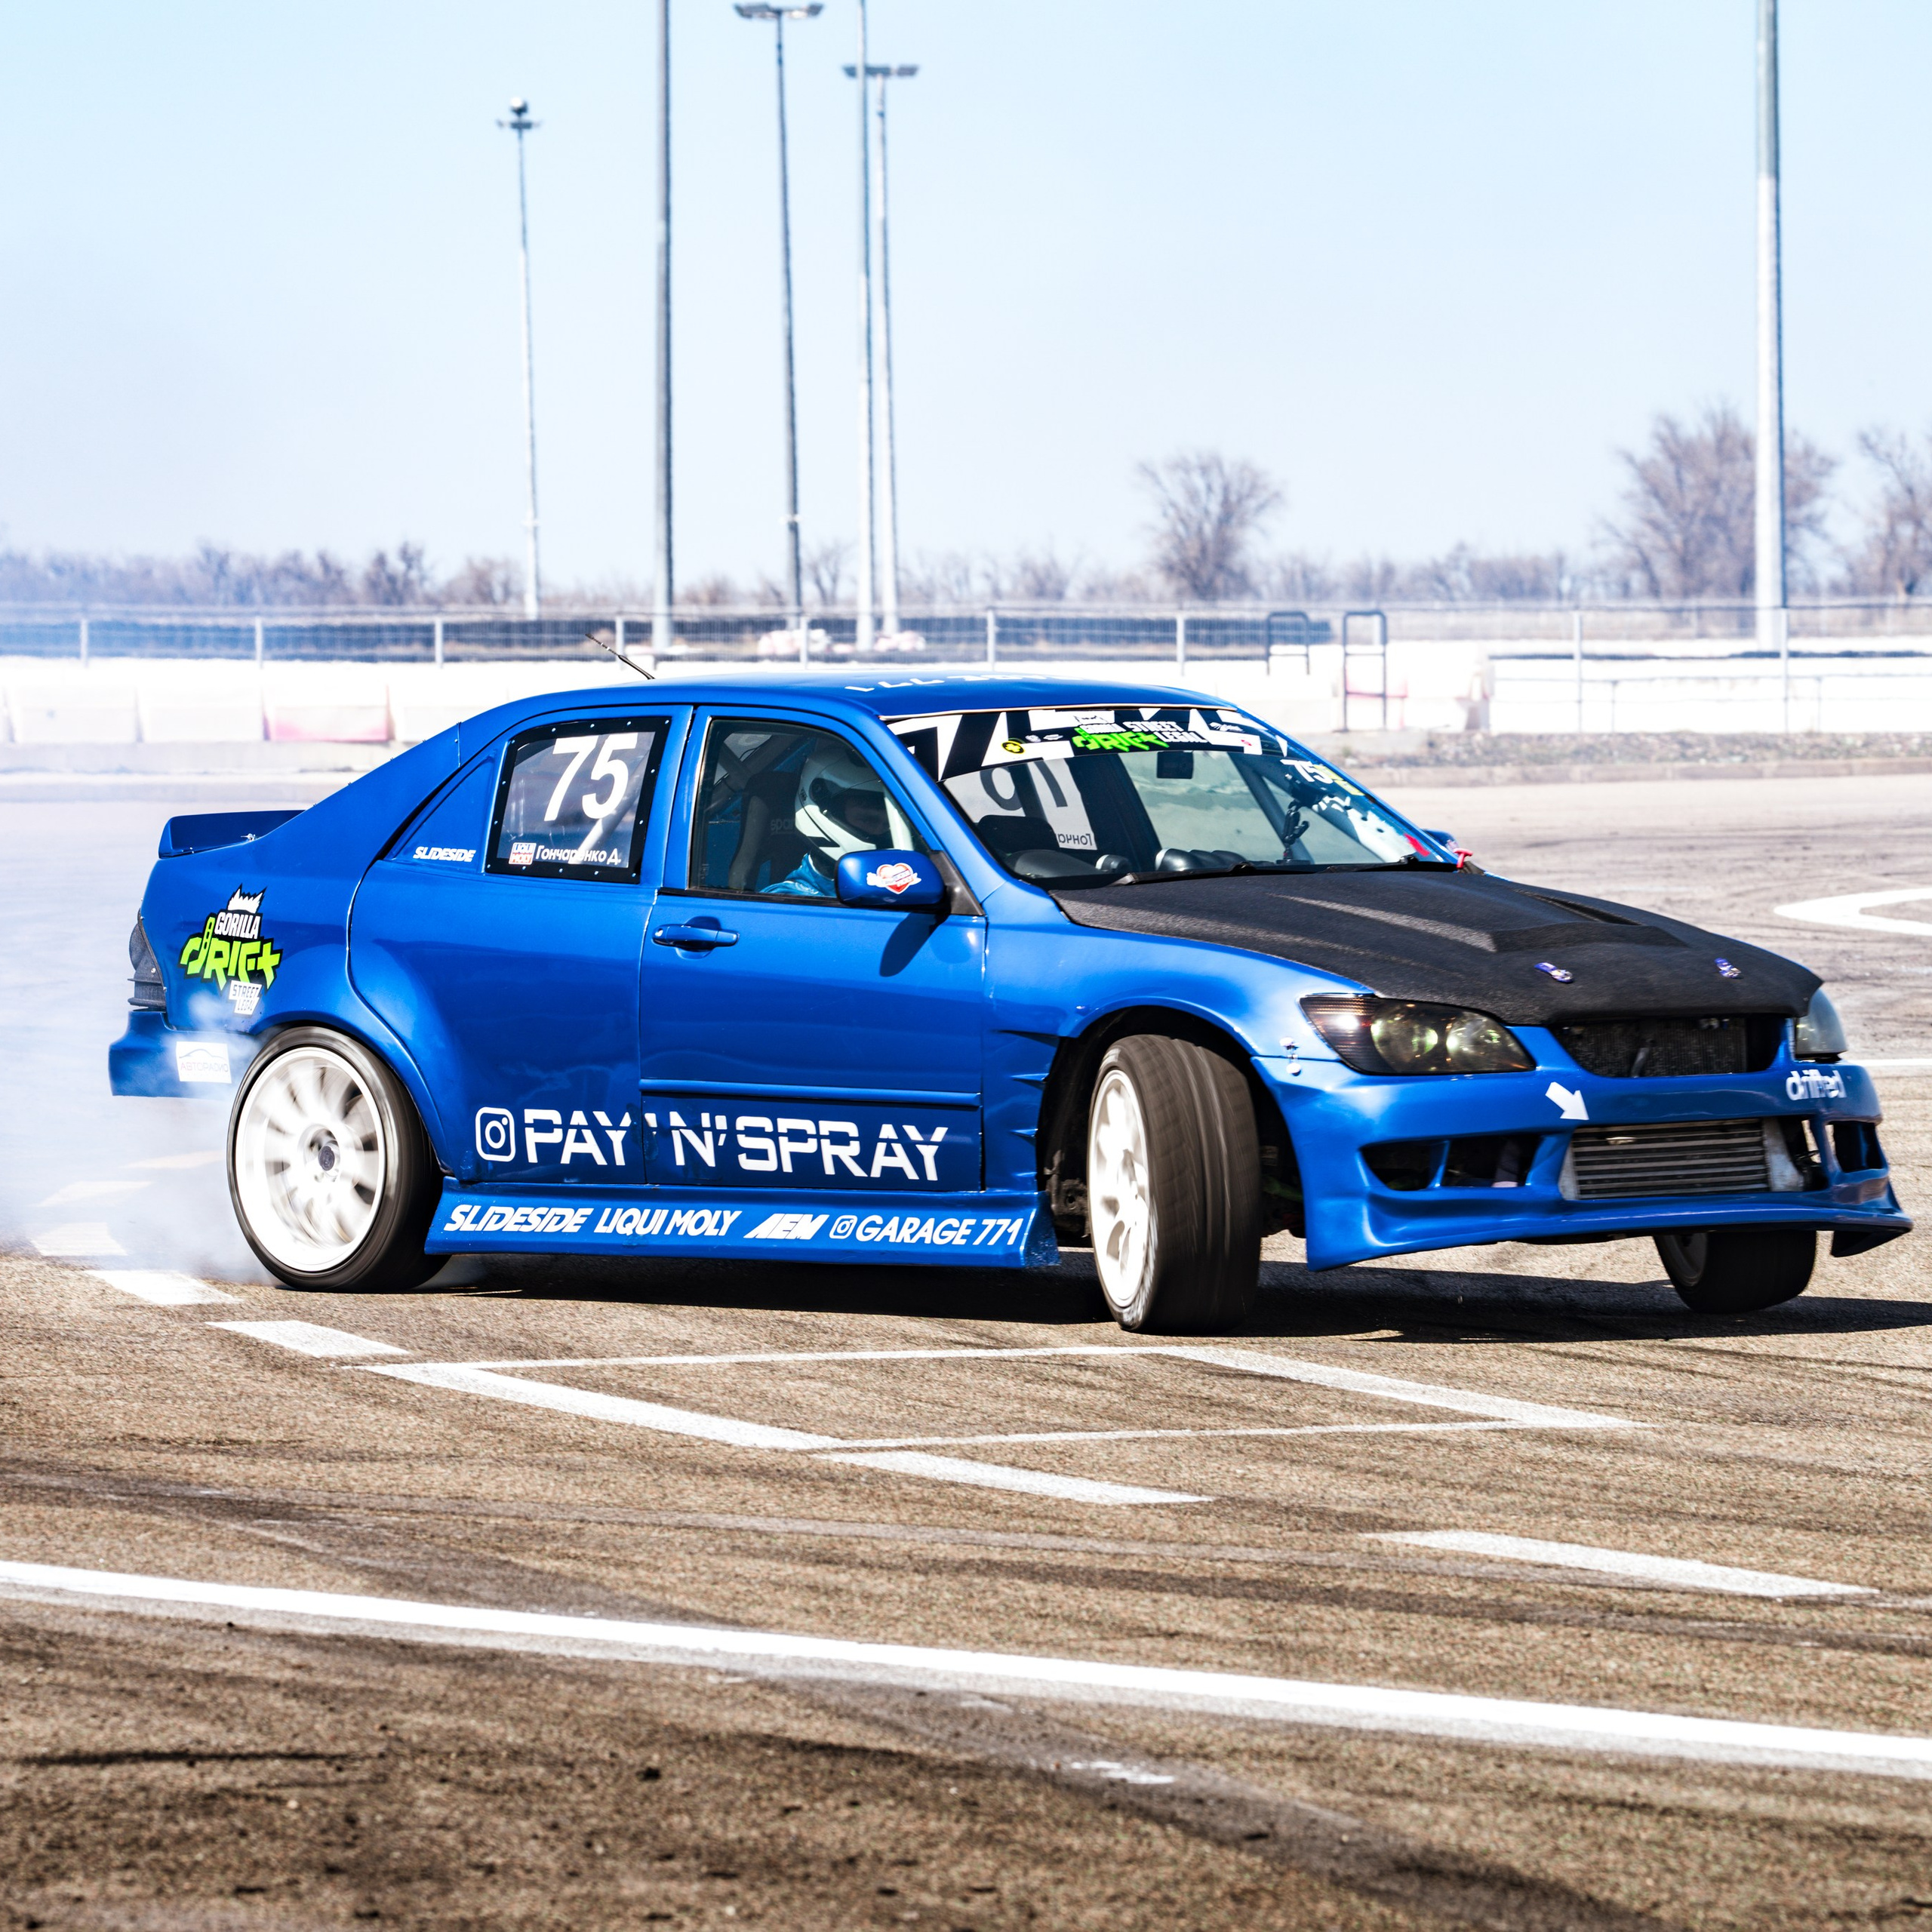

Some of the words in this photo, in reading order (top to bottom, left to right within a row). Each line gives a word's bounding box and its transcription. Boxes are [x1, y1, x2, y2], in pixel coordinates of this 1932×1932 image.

[543, 732, 638, 822] 75
[1280, 758, 1334, 784] 75
[413, 846, 476, 863] SLIDESIDE
[214, 911, 261, 940] GORILLA
[232, 984, 260, 998] STREET
[237, 998, 256, 1011] LEGAL
[444, 1204, 594, 1233] SLIDESIDE
[594, 1208, 669, 1236] LIQUI
[663, 1209, 743, 1236] MOLY
[743, 1212, 829, 1241] AEM
[855, 1214, 977, 1245] GARAGE
[973, 1217, 1023, 1246] 771
